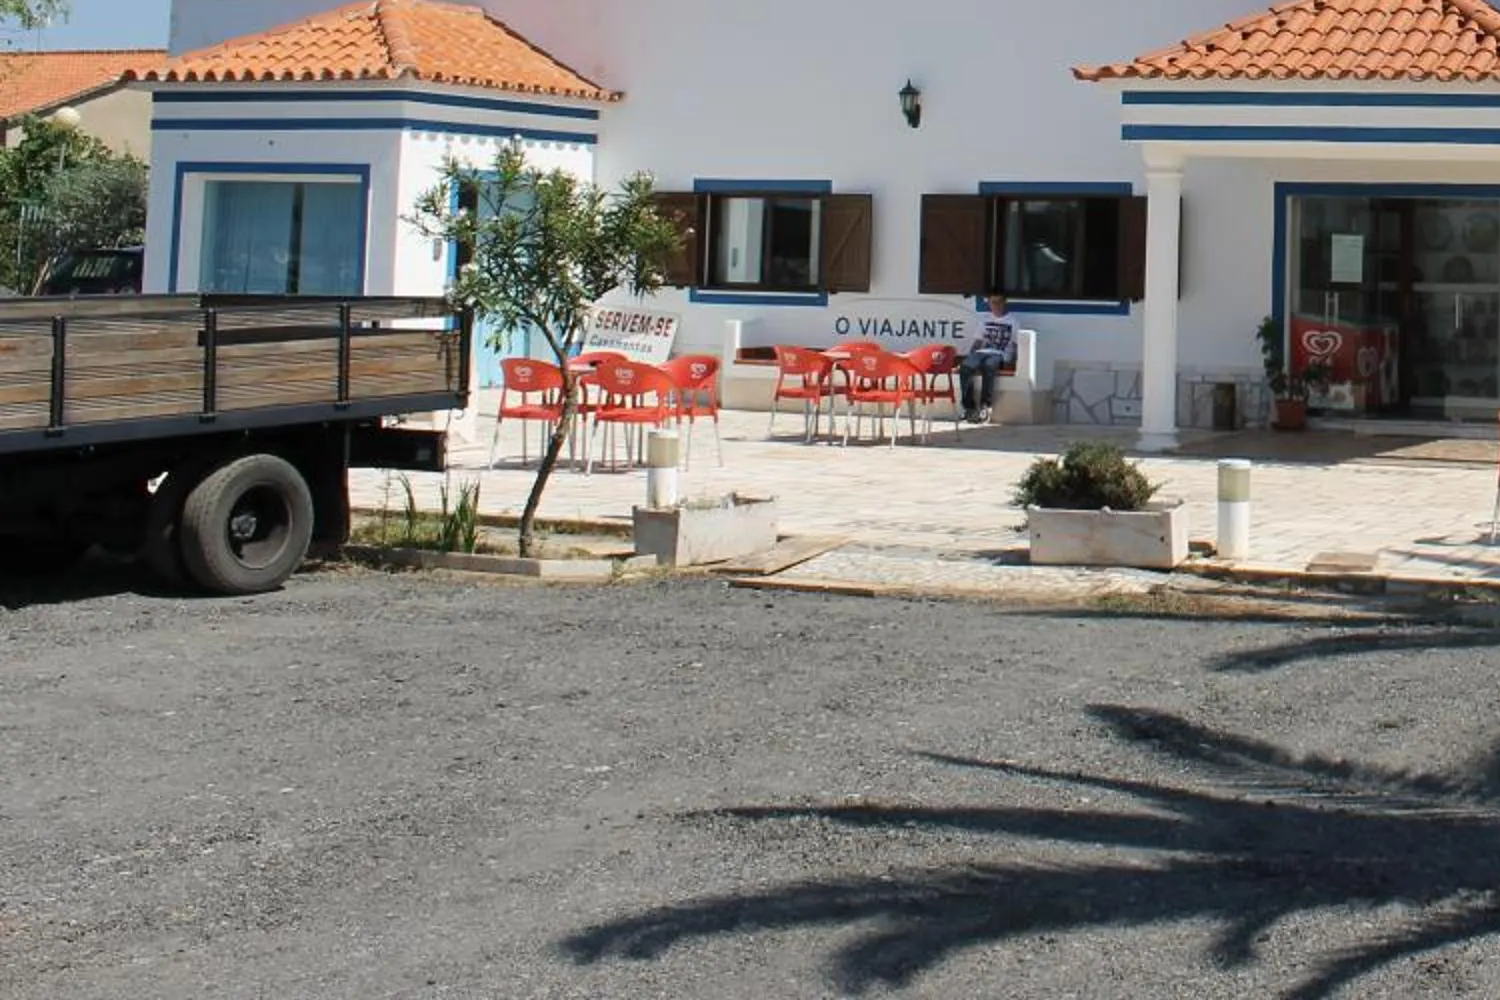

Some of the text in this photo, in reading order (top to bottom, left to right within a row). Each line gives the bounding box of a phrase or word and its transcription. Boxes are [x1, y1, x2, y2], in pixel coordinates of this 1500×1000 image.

[596, 310, 674, 337] SERVEM-SE
[835, 317, 850, 335] O
[859, 318, 965, 339] VIAJANTE
